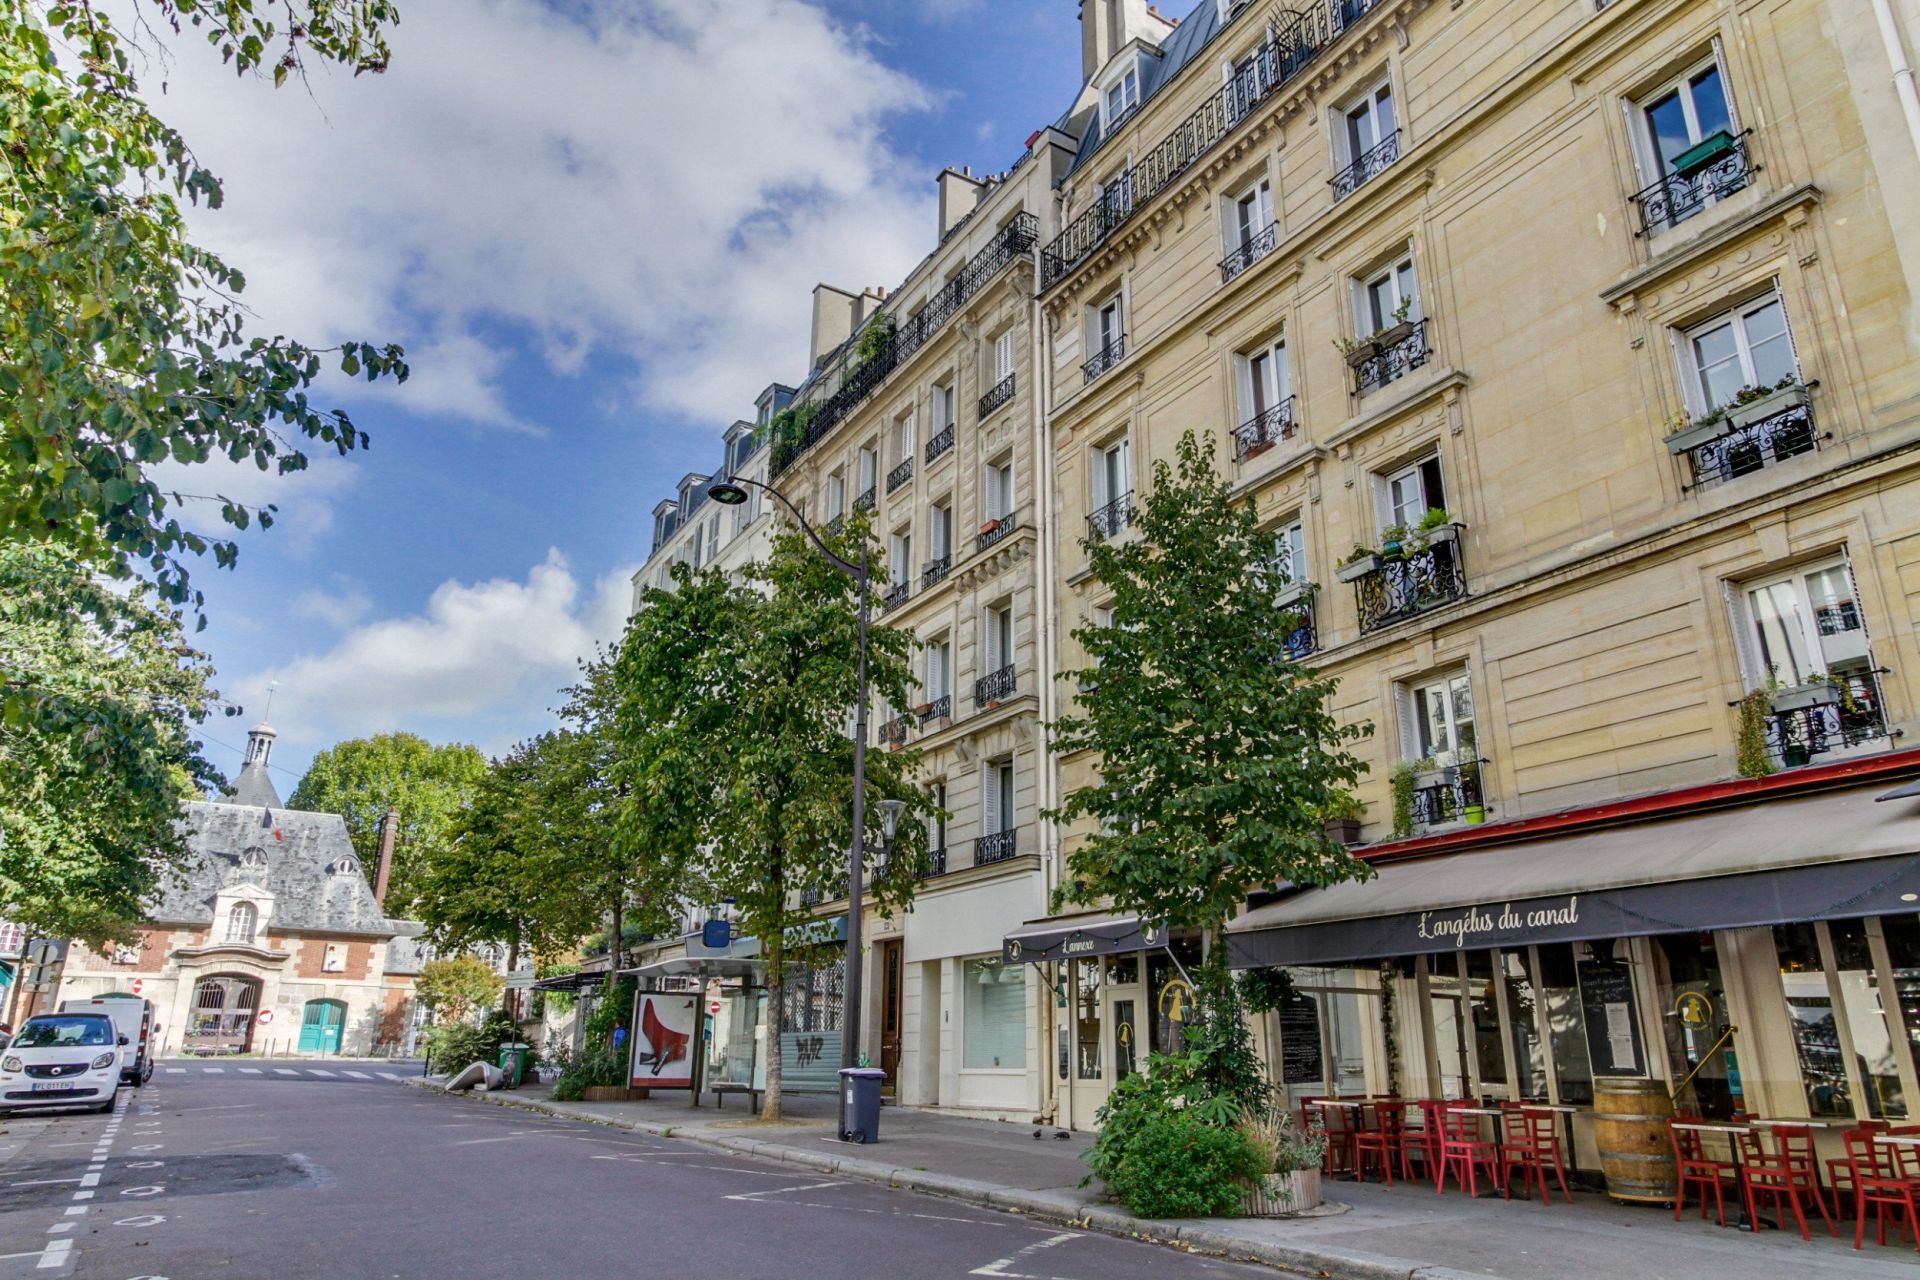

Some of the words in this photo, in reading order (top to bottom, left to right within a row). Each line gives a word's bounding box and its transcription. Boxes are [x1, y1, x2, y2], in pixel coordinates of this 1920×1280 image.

[1417, 907, 1494, 948] L'angélus
[1498, 903, 1523, 930] du
[1527, 896, 1579, 928] canal
